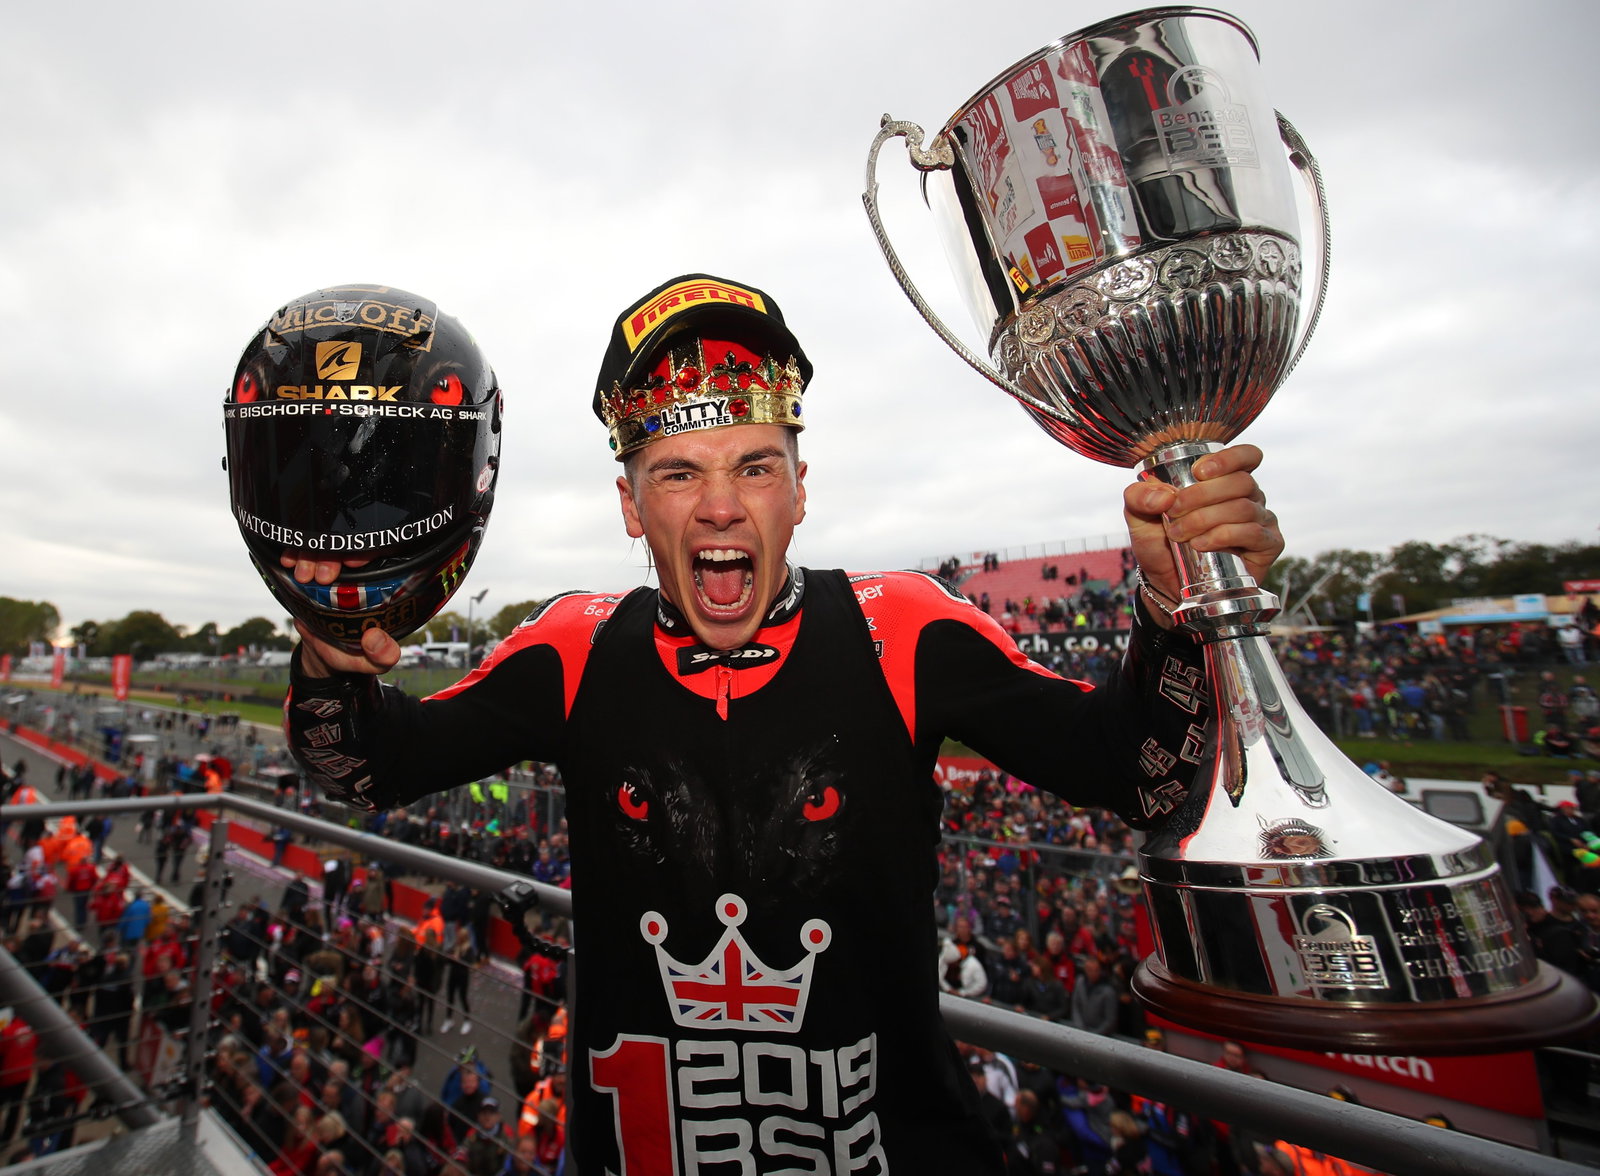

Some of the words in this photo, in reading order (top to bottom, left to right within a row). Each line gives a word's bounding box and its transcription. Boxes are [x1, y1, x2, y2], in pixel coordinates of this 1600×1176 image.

[631, 283, 754, 337] PIRELLI
[276, 385, 403, 401] SHARK
[240, 403, 323, 418] BISCHOFF
[339, 404, 425, 419] SCHECK
[430, 408, 453, 420] AG
[459, 410, 487, 421] SHARK
[664, 415, 731, 435] COMMITTEE
[237, 505, 304, 547] WATCHES
[308, 533, 327, 550] of
[330, 505, 454, 550] DISTINCTION
[584, 604, 605, 617] Be
[1404, 943, 1523, 979] CHMPION
[676, 1032, 877, 1119] 2019
[681, 1111, 889, 1176] BSB
